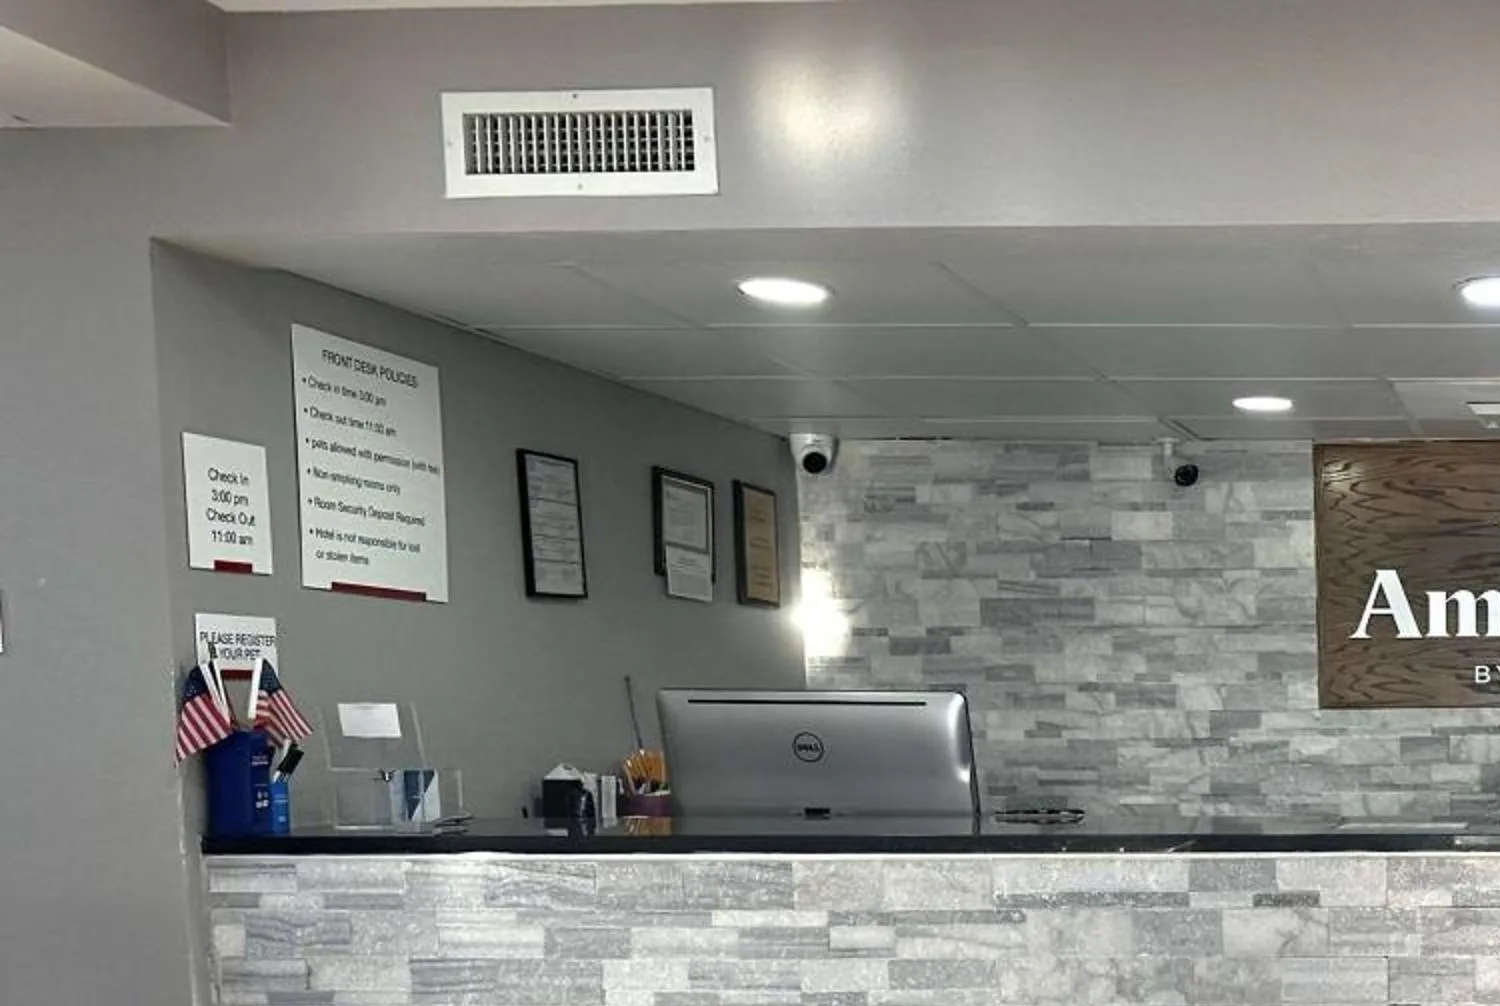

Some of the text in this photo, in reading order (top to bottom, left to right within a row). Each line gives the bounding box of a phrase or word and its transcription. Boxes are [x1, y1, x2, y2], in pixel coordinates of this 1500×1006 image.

[321, 349, 419, 389] FRONT DESK POLICIES
[307, 375, 332, 391] Check
[309, 406, 333, 421] Check
[207, 467, 250, 487] Check In
[211, 488, 249, 507] 3:00 pm
[313, 496, 337, 511] Room
[338, 500, 367, 519] Security
[206, 507, 256, 527] Check Out
[211, 530, 253, 545] 11:00 am
[199, 631, 276, 648] PLEASE REGISTER
[219, 646, 261, 661] YOUR PET
